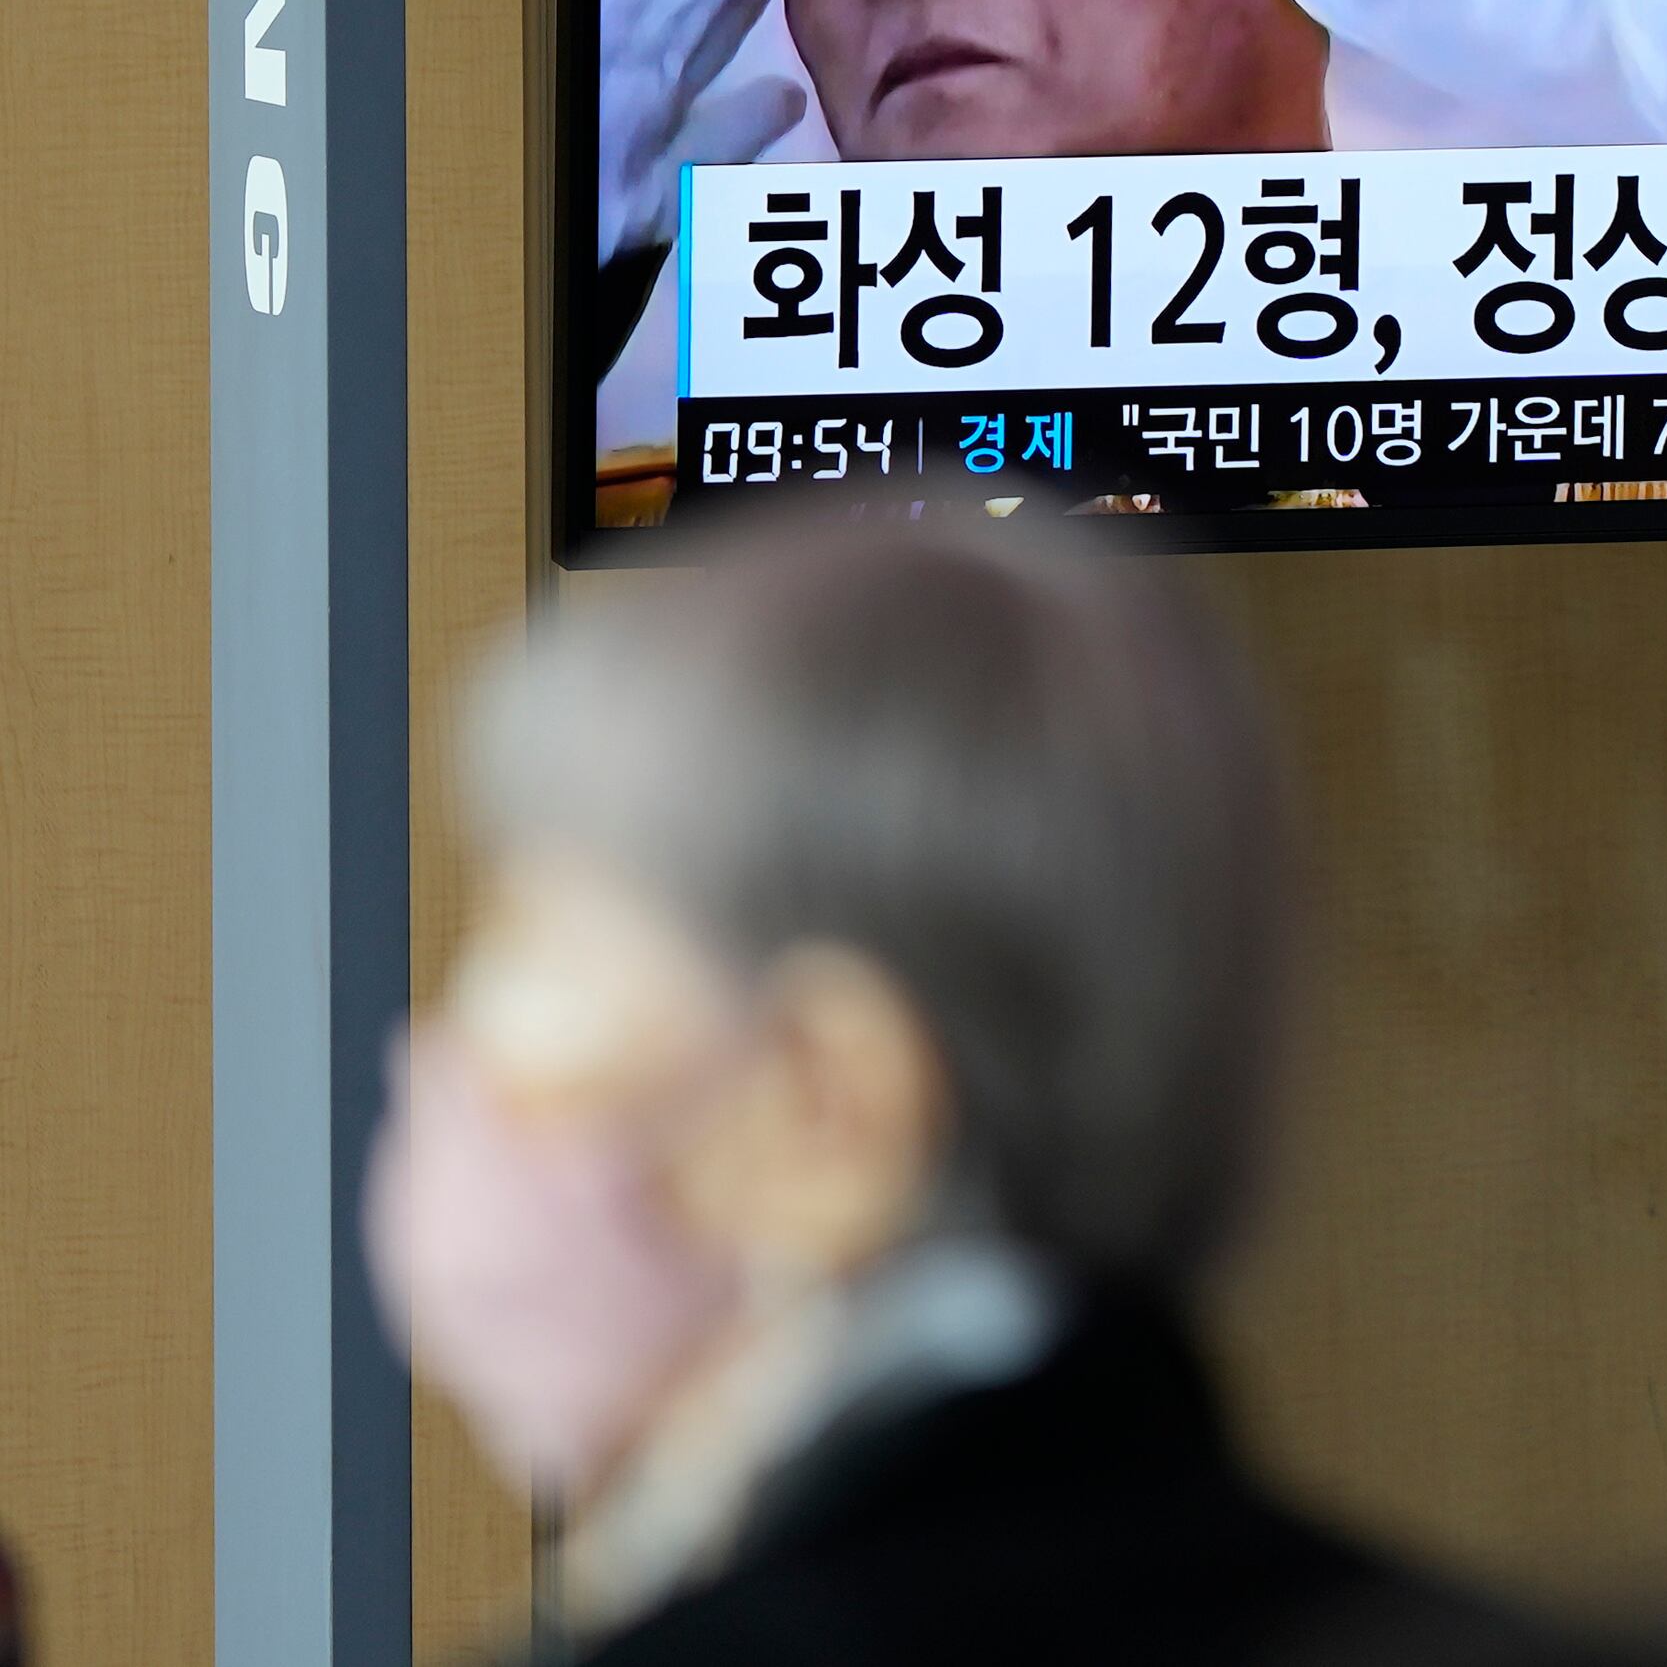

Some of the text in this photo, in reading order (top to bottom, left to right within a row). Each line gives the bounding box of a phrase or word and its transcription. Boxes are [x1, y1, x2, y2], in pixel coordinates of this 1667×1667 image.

[741, 185, 1004, 370] 화성
[1066, 176, 1403, 374] 12형,
[701, 419, 893, 483] 09:54
[1120, 402, 1261, 472] "국민
[1289, 399, 1425, 464] 10명
[1448, 397, 1625, 464] 가운데
